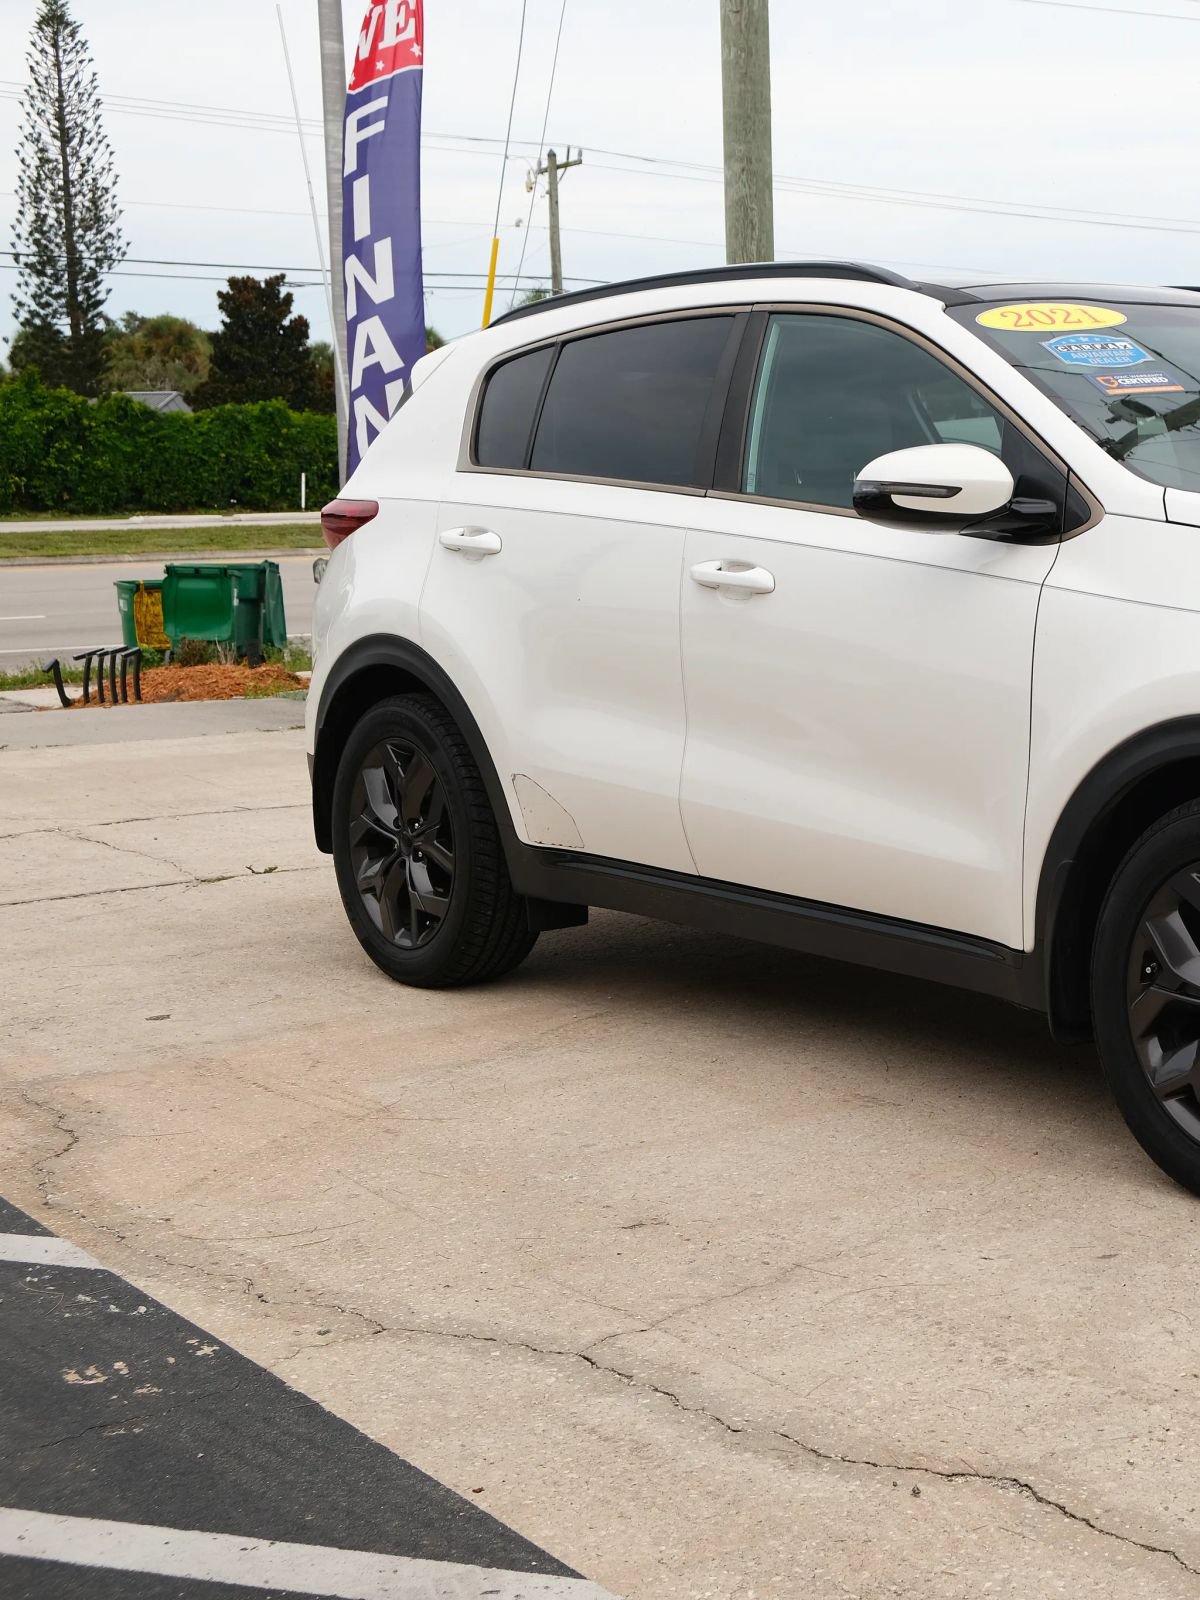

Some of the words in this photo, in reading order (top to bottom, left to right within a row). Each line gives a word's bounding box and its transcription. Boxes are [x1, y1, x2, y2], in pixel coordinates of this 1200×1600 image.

[1000, 308, 1106, 327] 2021
[1054, 342, 1135, 353] CARFAX
[1070, 350, 1137, 359] ADVANTAGE
[1087, 356, 1133, 365] DEALER
[1117, 376, 1169, 385] CERTIFIED
